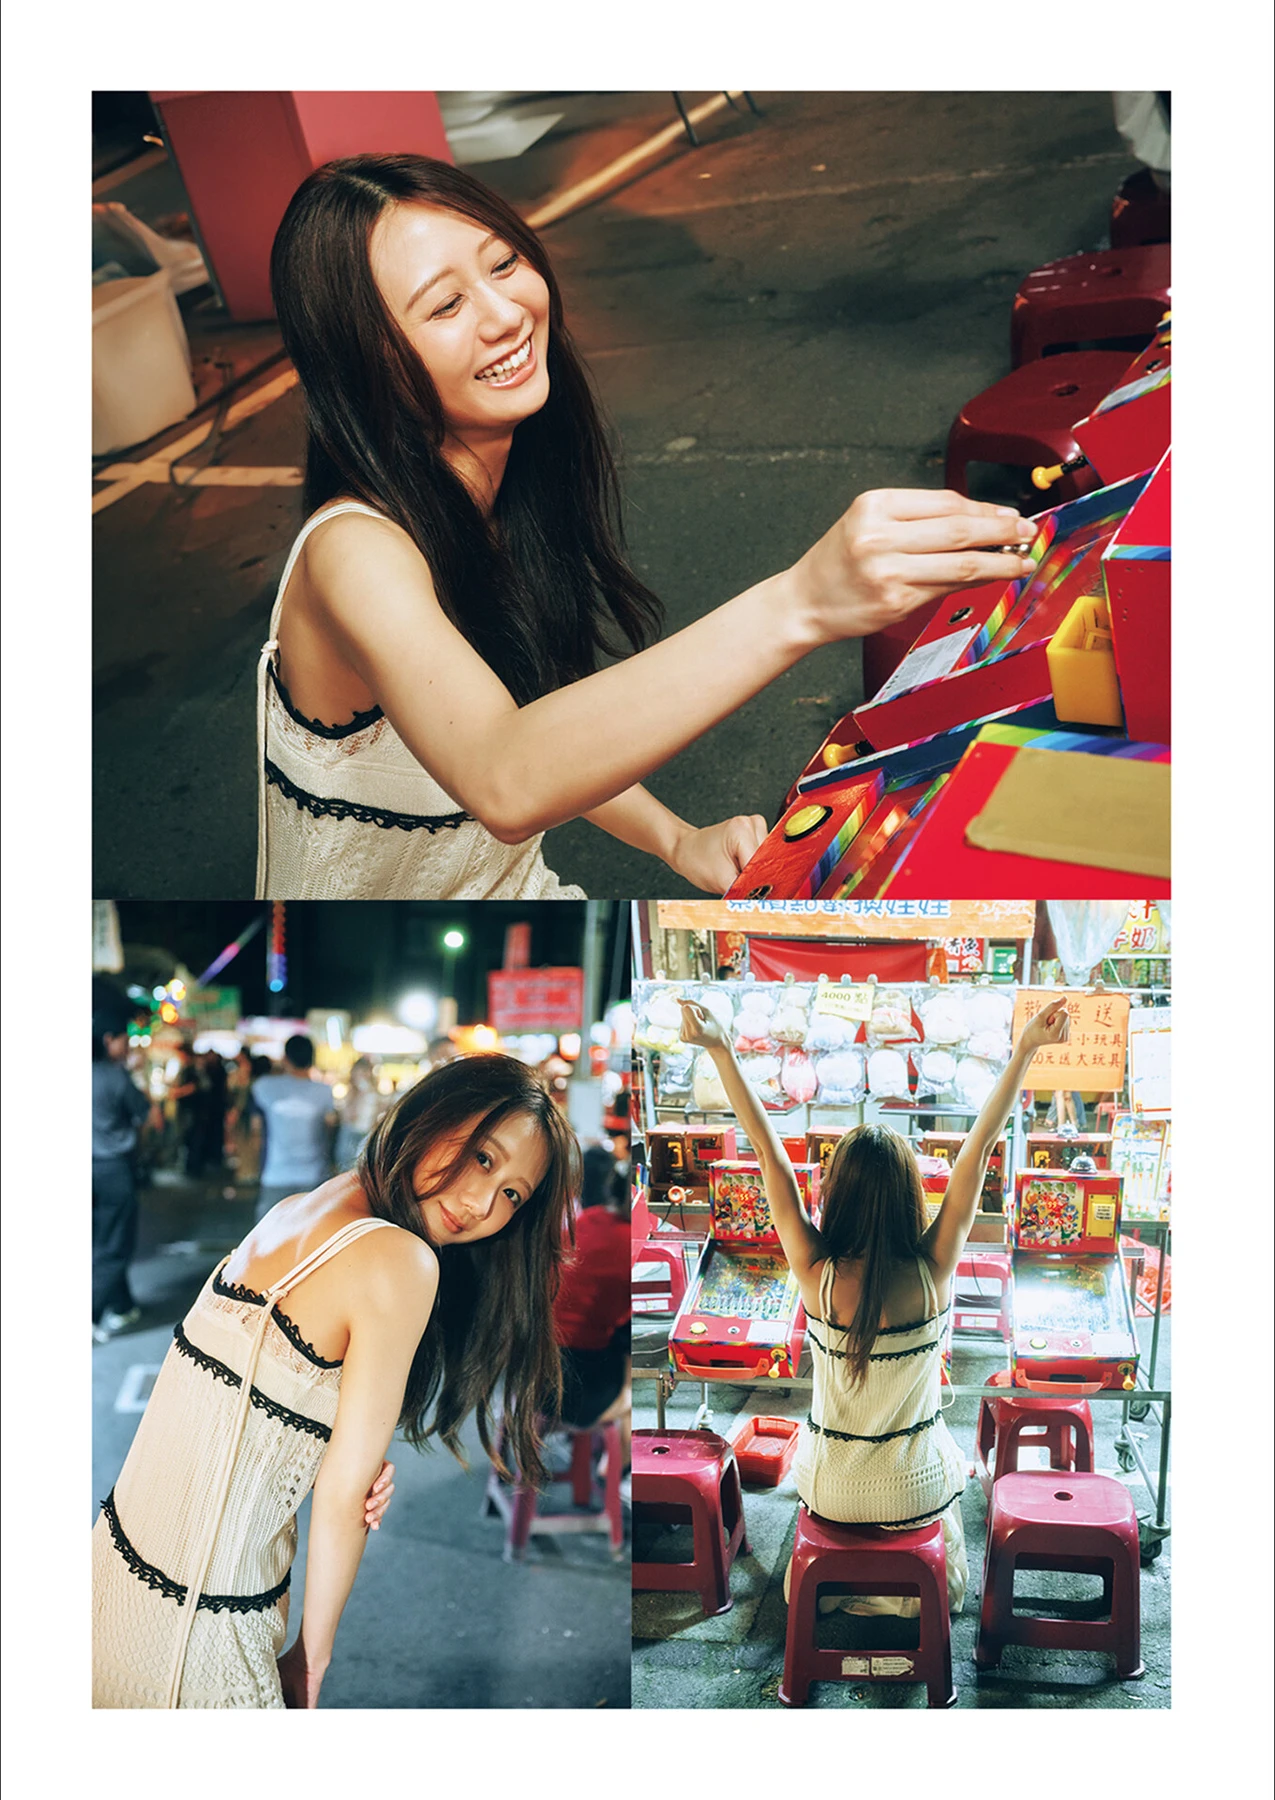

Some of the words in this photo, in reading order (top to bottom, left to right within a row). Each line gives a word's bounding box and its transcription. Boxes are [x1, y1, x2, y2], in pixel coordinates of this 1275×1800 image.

[821, 991, 851, 1002] 4000
[1066, 1033, 1124, 1046] 小玩具
